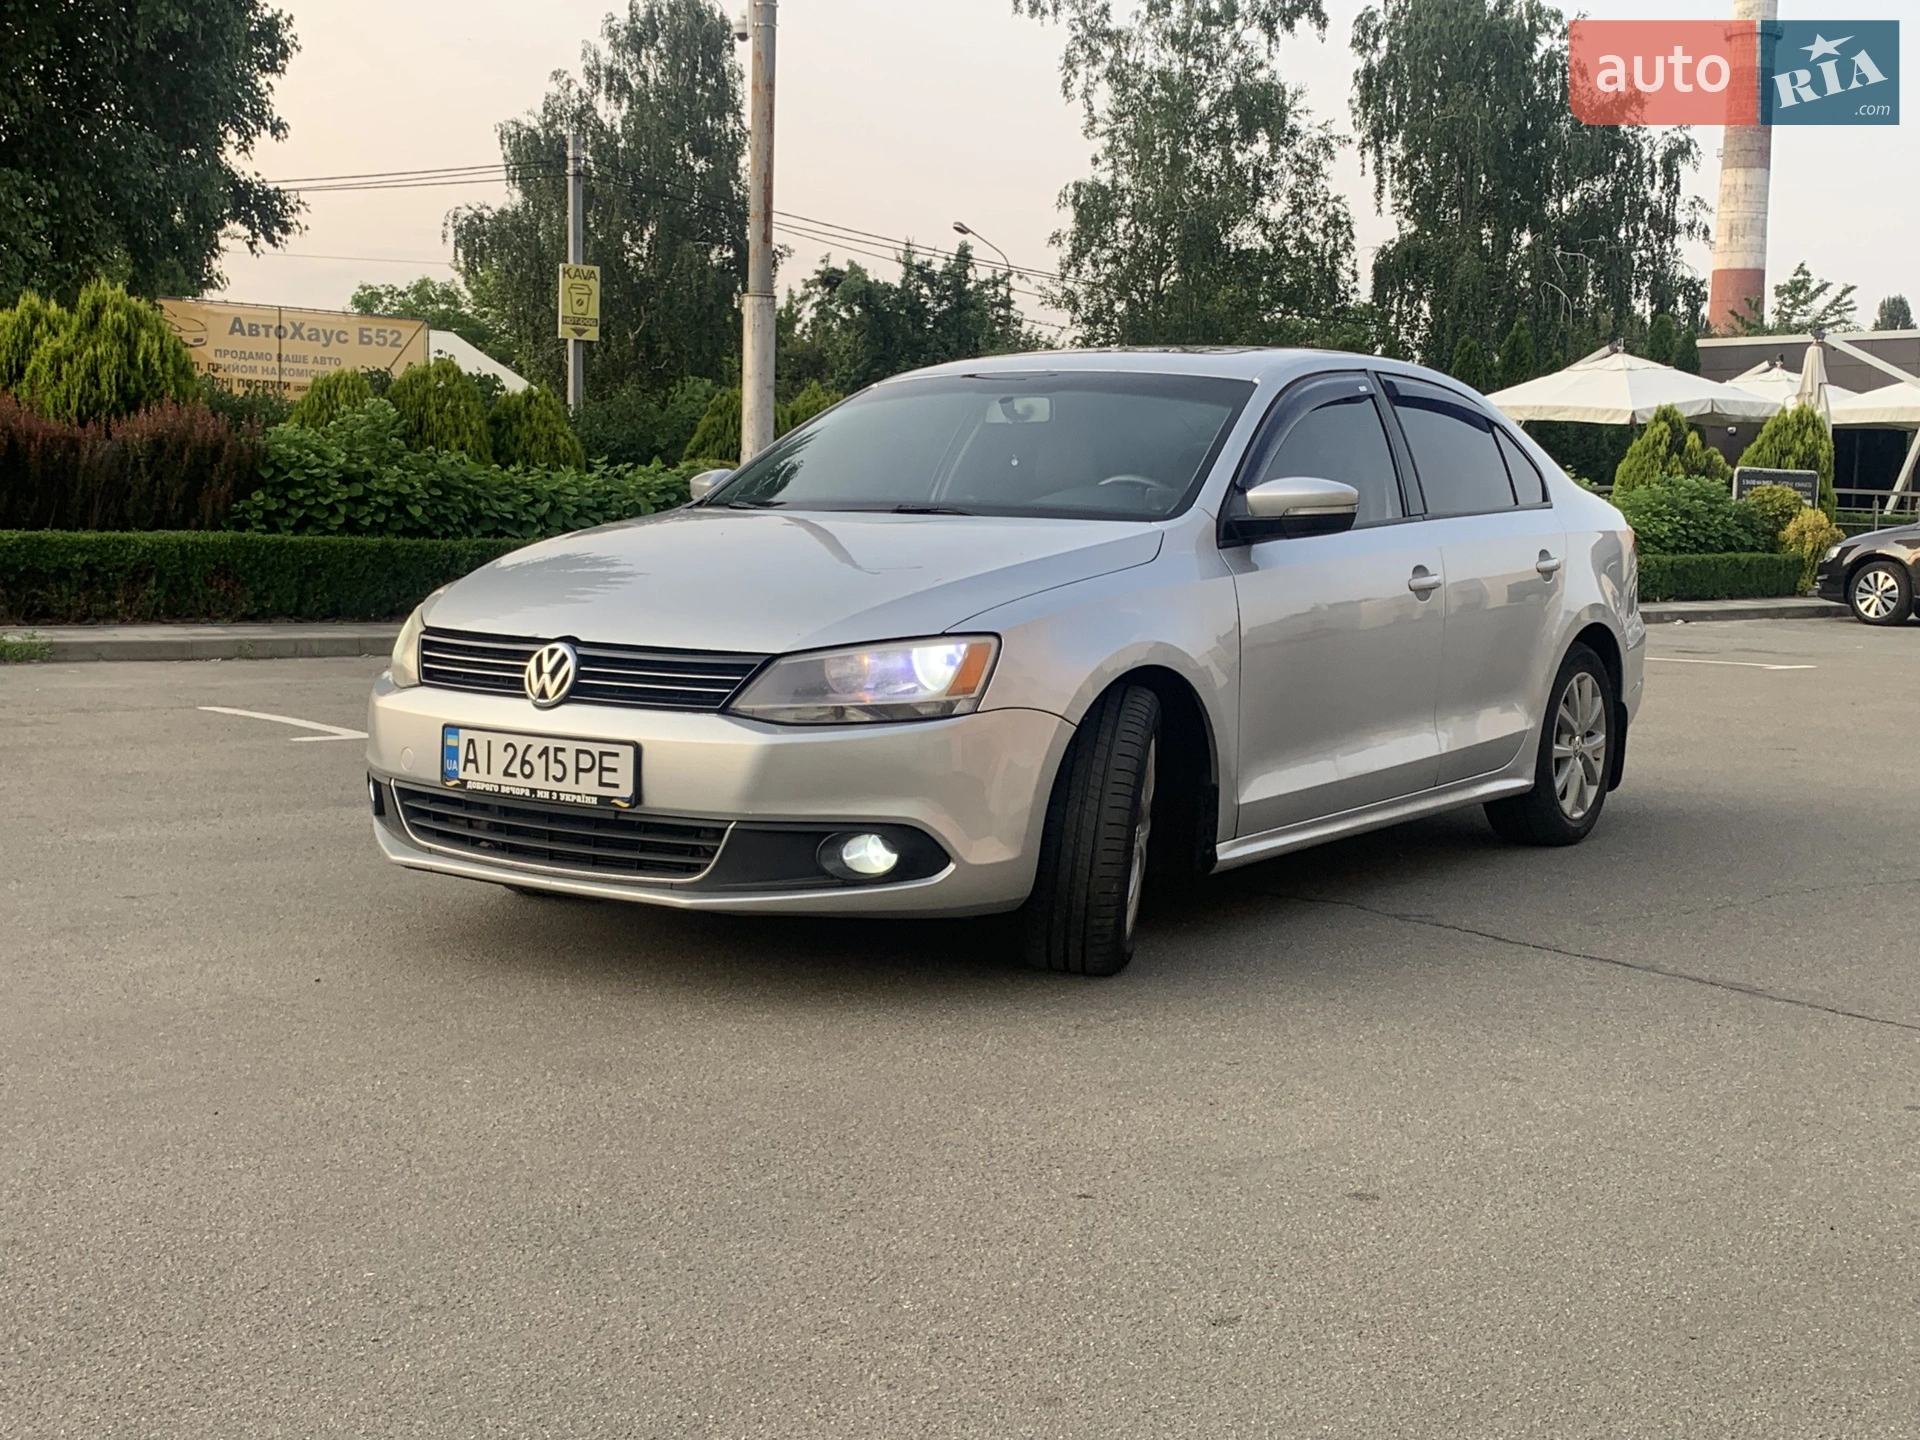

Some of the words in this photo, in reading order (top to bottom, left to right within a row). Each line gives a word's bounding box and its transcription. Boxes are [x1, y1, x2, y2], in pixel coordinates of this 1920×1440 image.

[562, 267, 598, 282] KAVA
[228, 316, 349, 348] АвтоХаус
[358, 327, 403, 348] Б52
[214, 348, 273, 362] ПРОДАМО
[276, 352, 308, 365] ВАШЕ
[312, 355, 342, 366] АВТО
[261, 366, 277, 376] НА
[446, 758, 458, 771] UA
[462, 737, 492, 775] AI
[575, 747, 620, 789] PE
